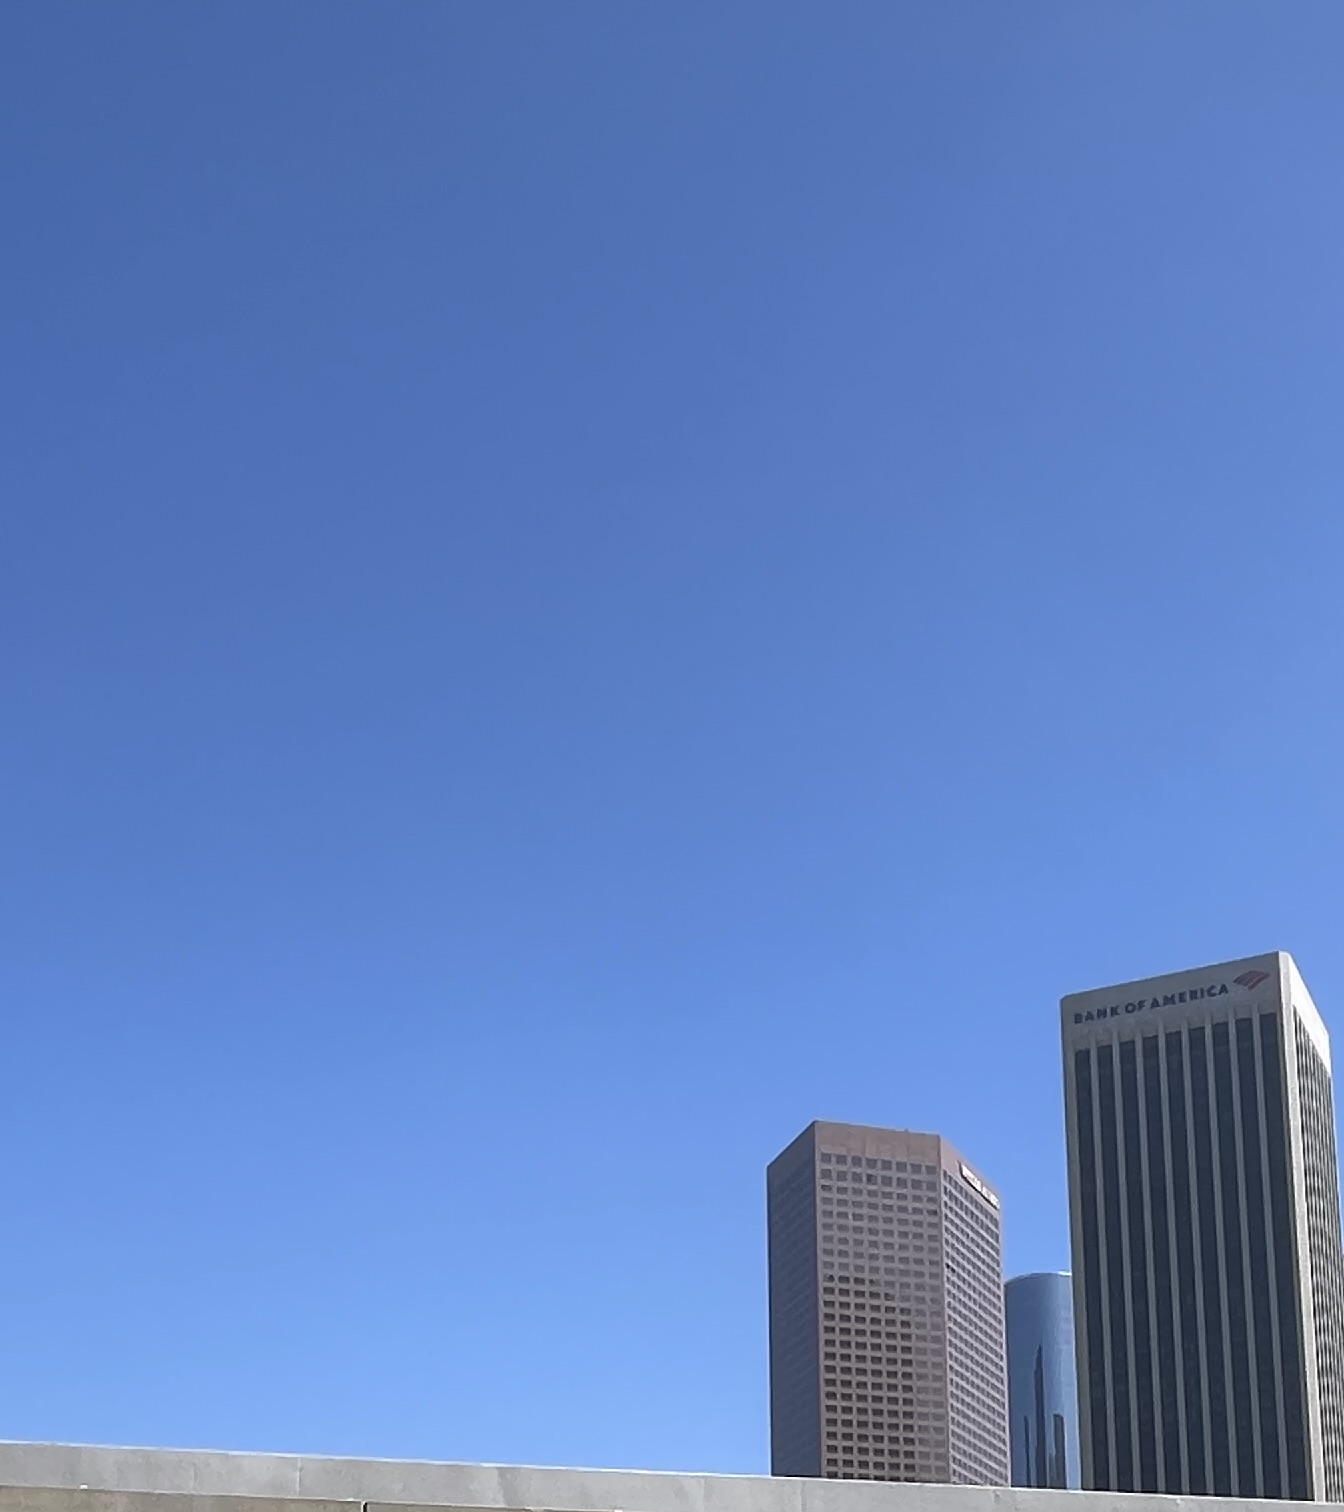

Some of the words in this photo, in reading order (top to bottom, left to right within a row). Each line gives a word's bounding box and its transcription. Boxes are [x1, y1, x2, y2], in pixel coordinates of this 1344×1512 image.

[1074, 1005, 1120, 1024] BANK
[1125, 999, 1147, 1014] OF
[1151, 984, 1228, 1009] AMERICA
